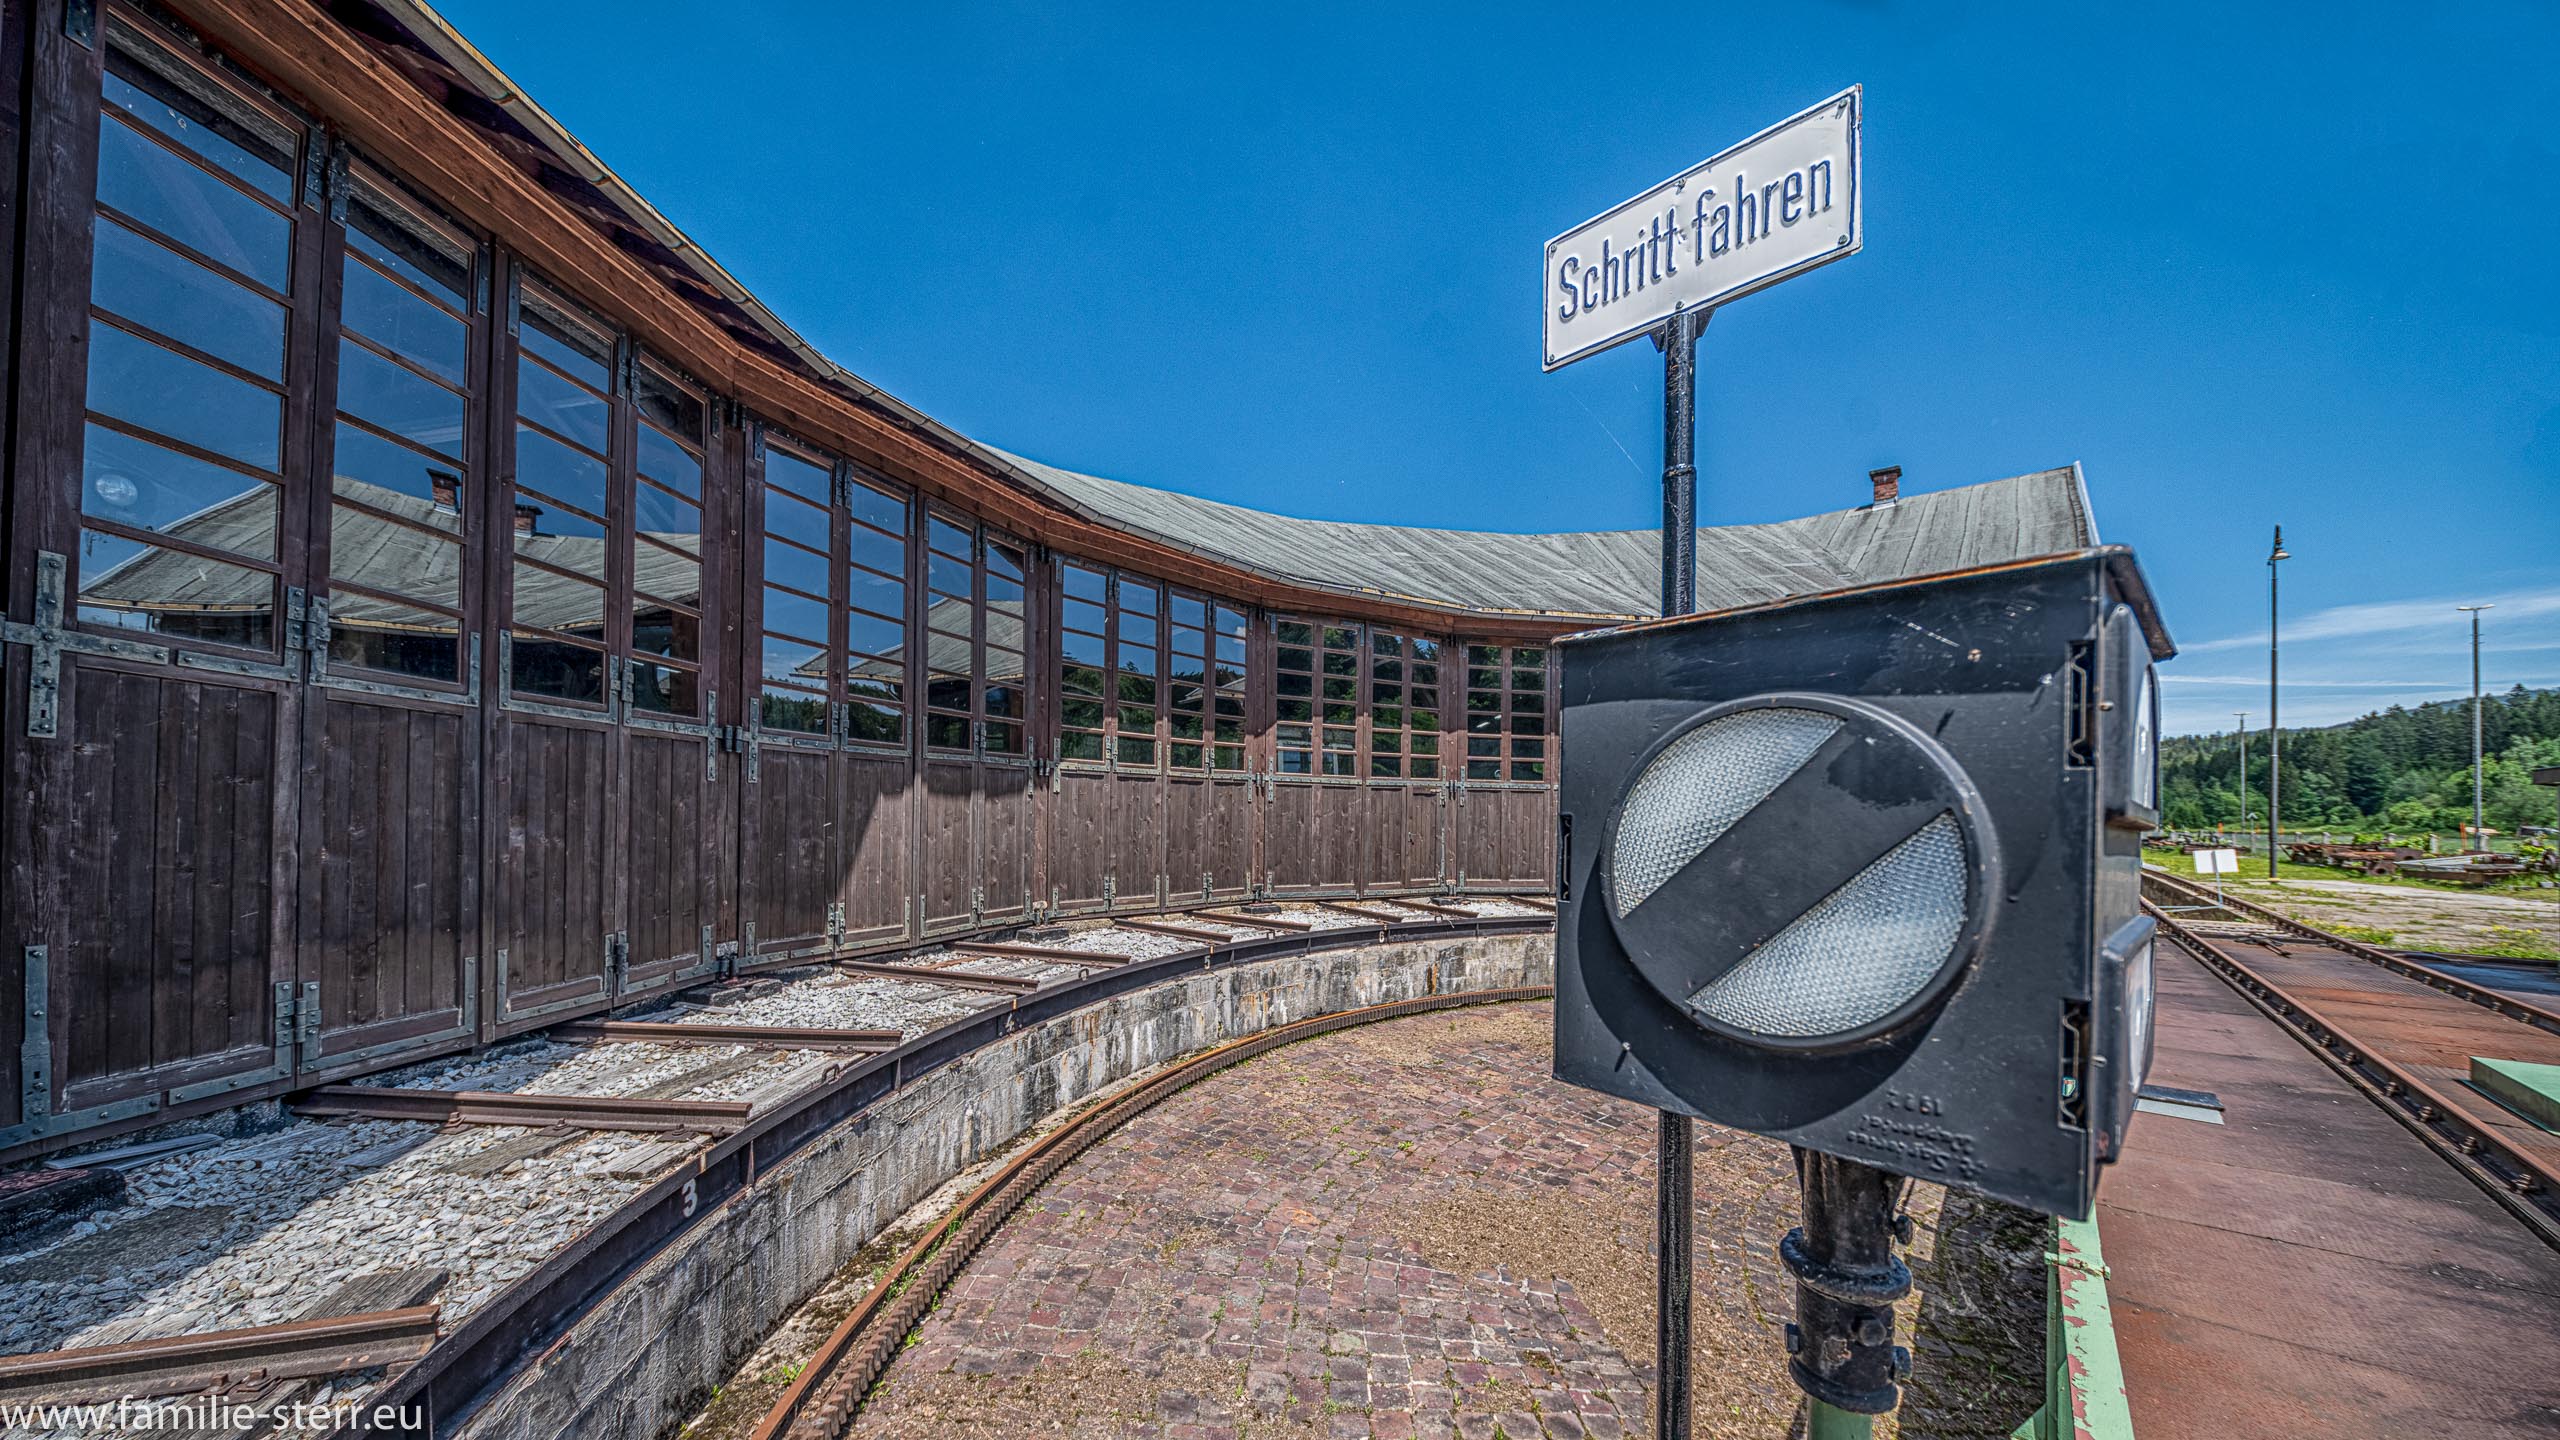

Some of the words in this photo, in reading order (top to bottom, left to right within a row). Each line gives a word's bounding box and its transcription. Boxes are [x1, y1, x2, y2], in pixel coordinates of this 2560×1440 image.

[1559, 207, 1678, 320] Schritt
[1692, 158, 1831, 264] fahren
[1379, 930, 1385, 943] 6
[1204, 955, 1211, 970] 5
[681, 1177, 698, 1218] 3
